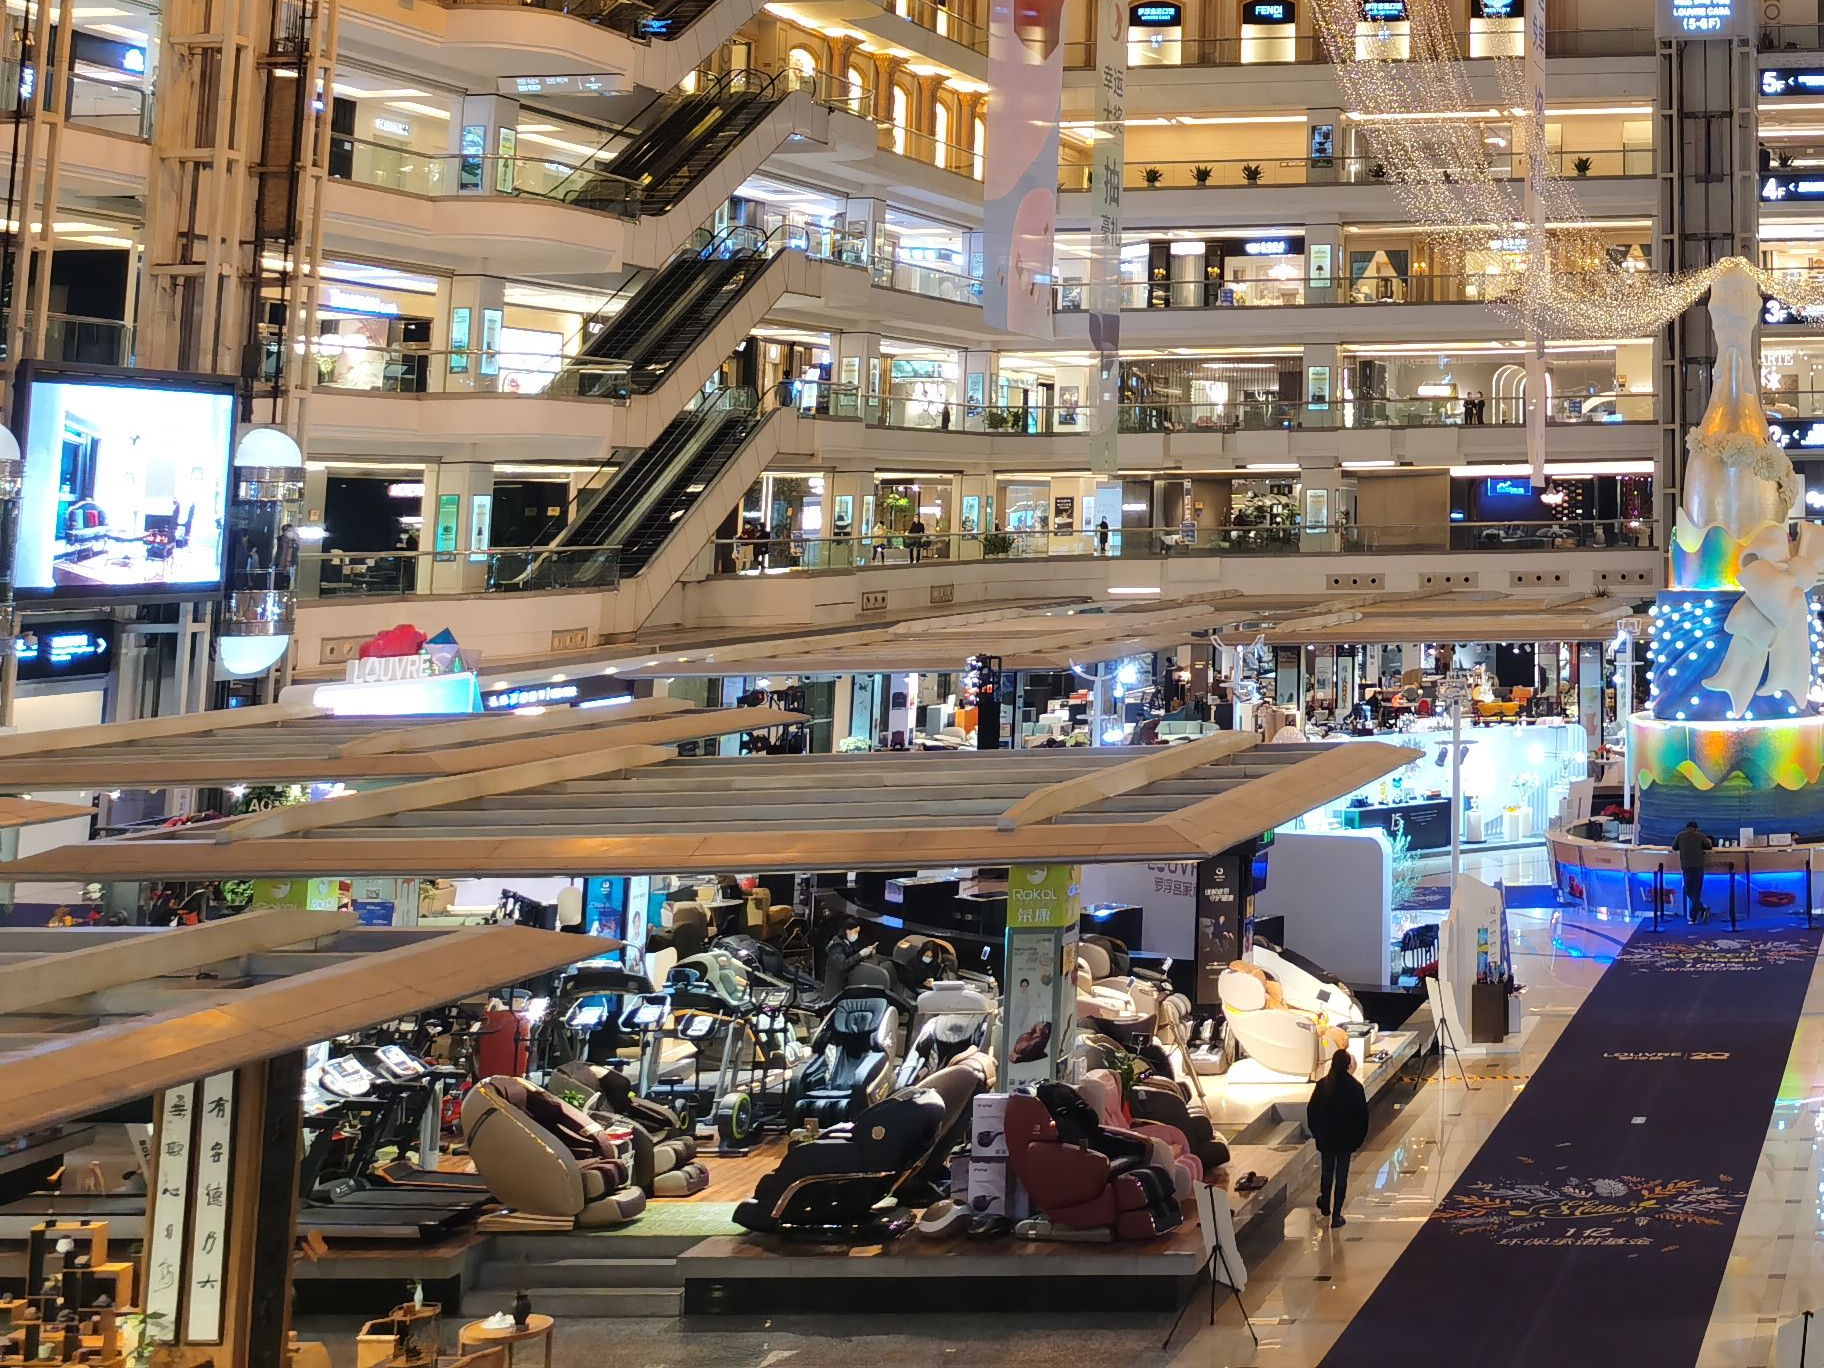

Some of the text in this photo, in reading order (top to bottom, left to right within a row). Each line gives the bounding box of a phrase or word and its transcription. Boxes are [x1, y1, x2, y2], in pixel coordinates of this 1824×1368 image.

[1255, 5, 1283, 15] FENDI
[1103, 63, 1123, 98] 幸运
[1763, 71, 1786, 93] 5F
[1104, 155, 1120, 208] 抽
[1762, 177, 1786, 199] 4F
[1765, 300, 1788, 323] 3F
